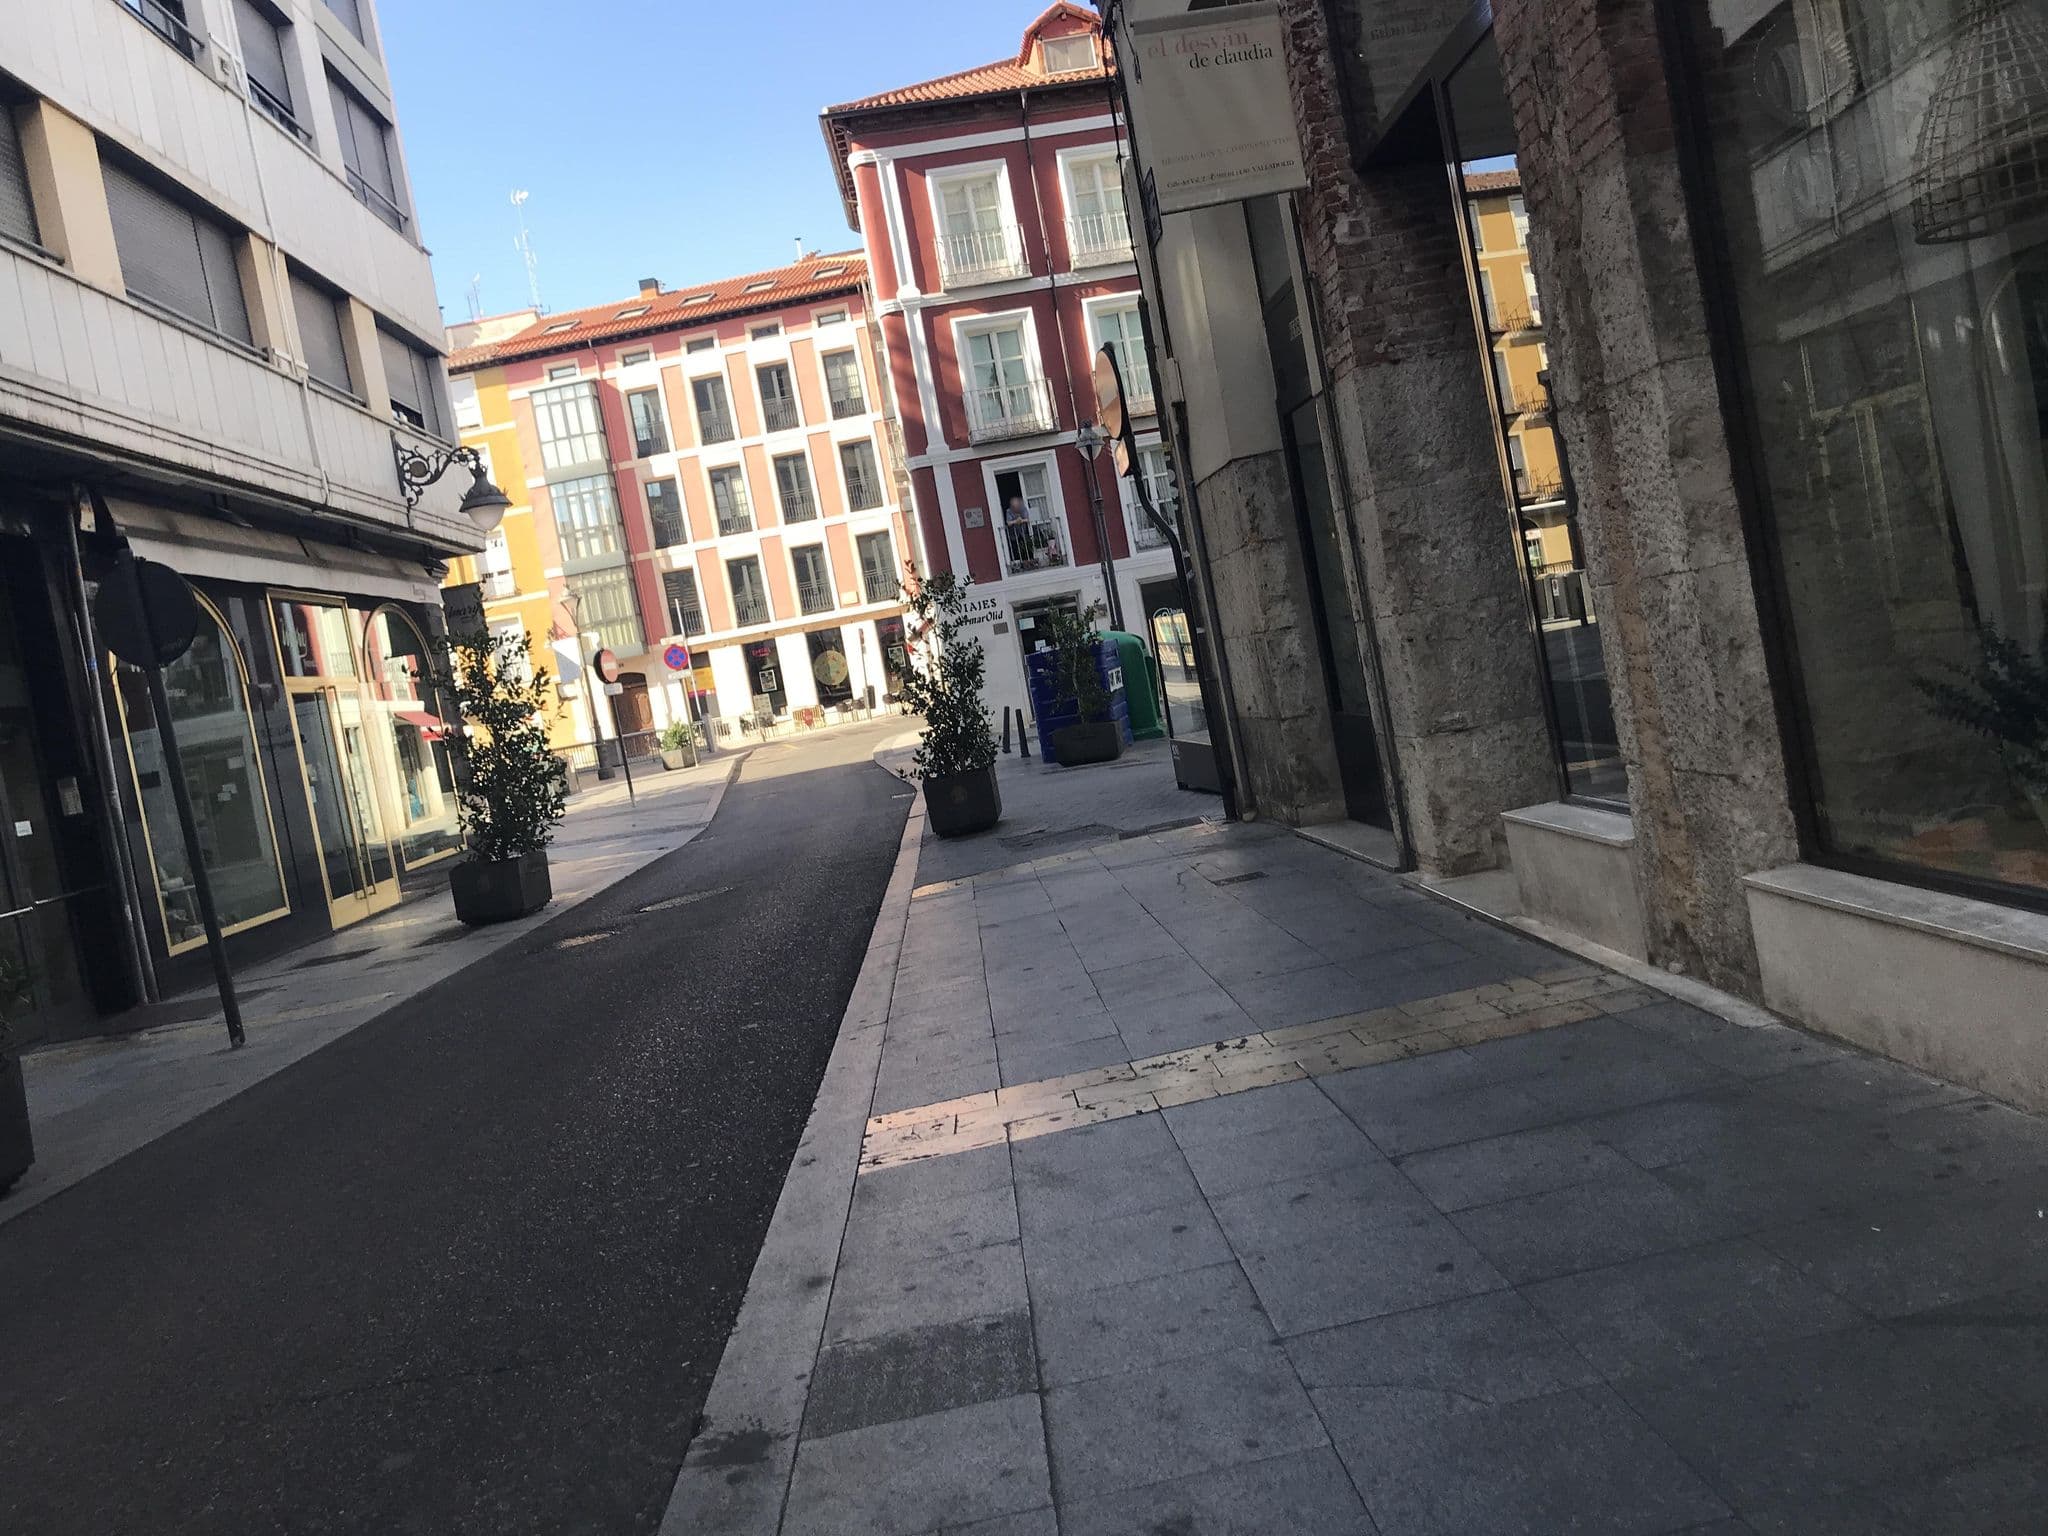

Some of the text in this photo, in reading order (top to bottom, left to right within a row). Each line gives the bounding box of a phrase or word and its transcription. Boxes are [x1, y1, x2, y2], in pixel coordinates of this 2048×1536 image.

[1189, 42, 1273, 69] de claudia
[955, 598, 997, 613] VIAJES
